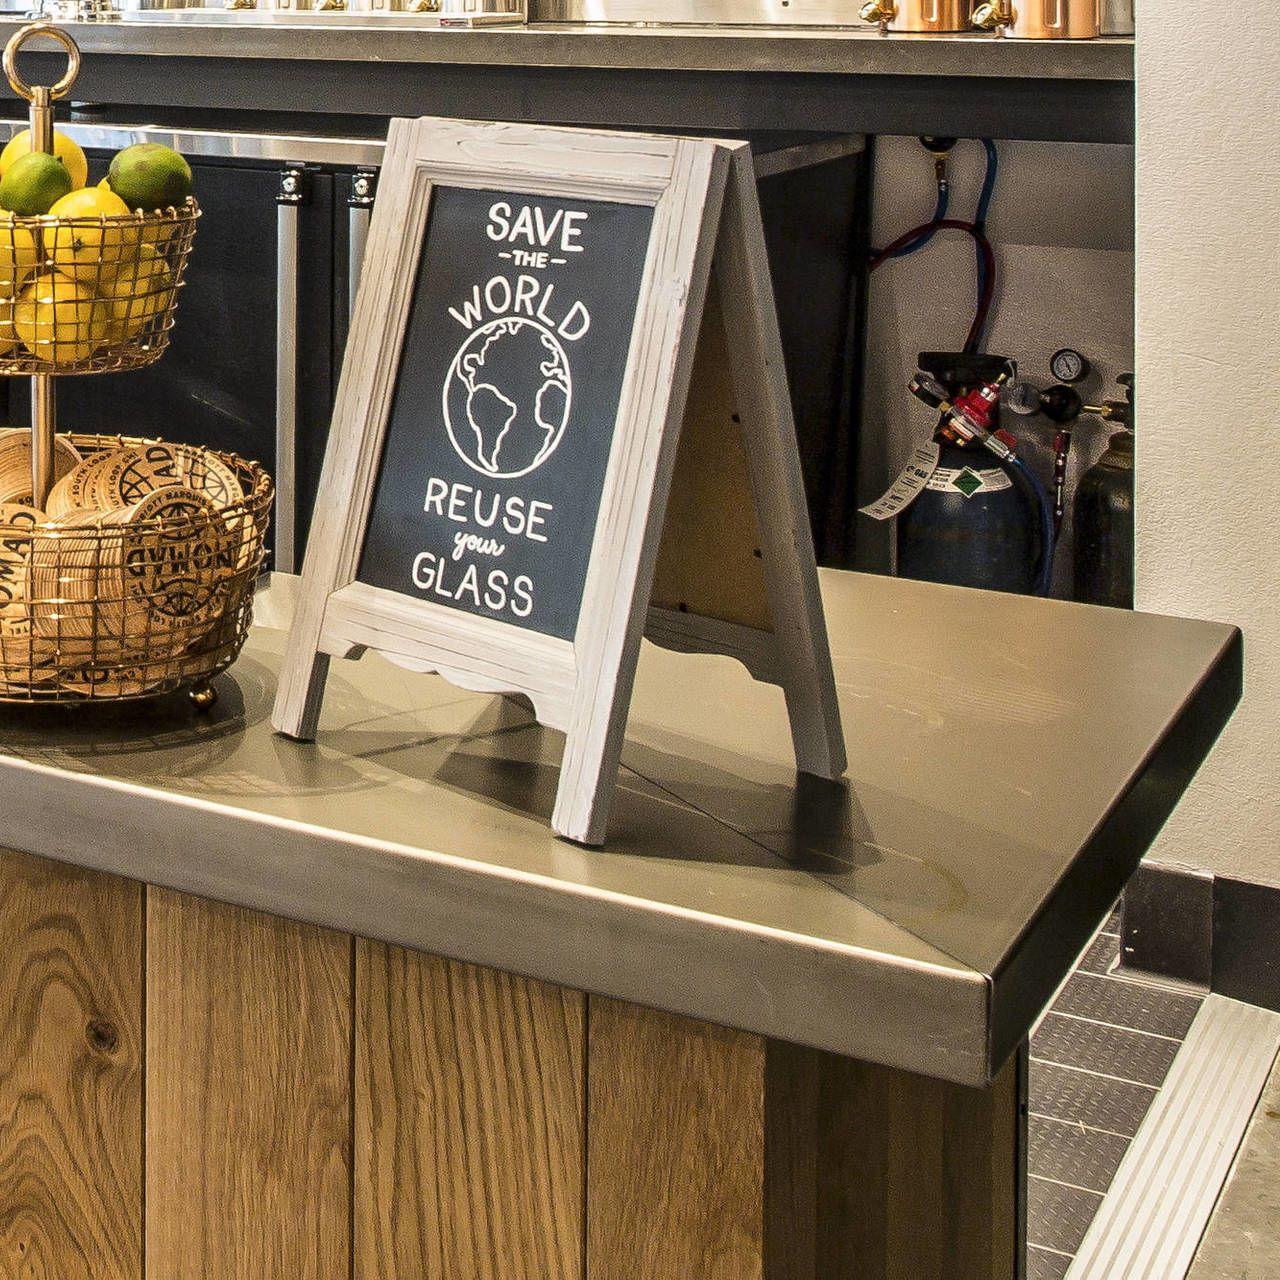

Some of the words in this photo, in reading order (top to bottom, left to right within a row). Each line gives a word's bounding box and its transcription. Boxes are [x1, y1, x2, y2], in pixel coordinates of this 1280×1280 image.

[485, 201, 589, 252] SAVE
[448, 274, 590, 342] WORLD
[424, 477, 554, 543] REUSE
[452, 530, 506, 561] your
[411, 551, 535, 618] GLASS
